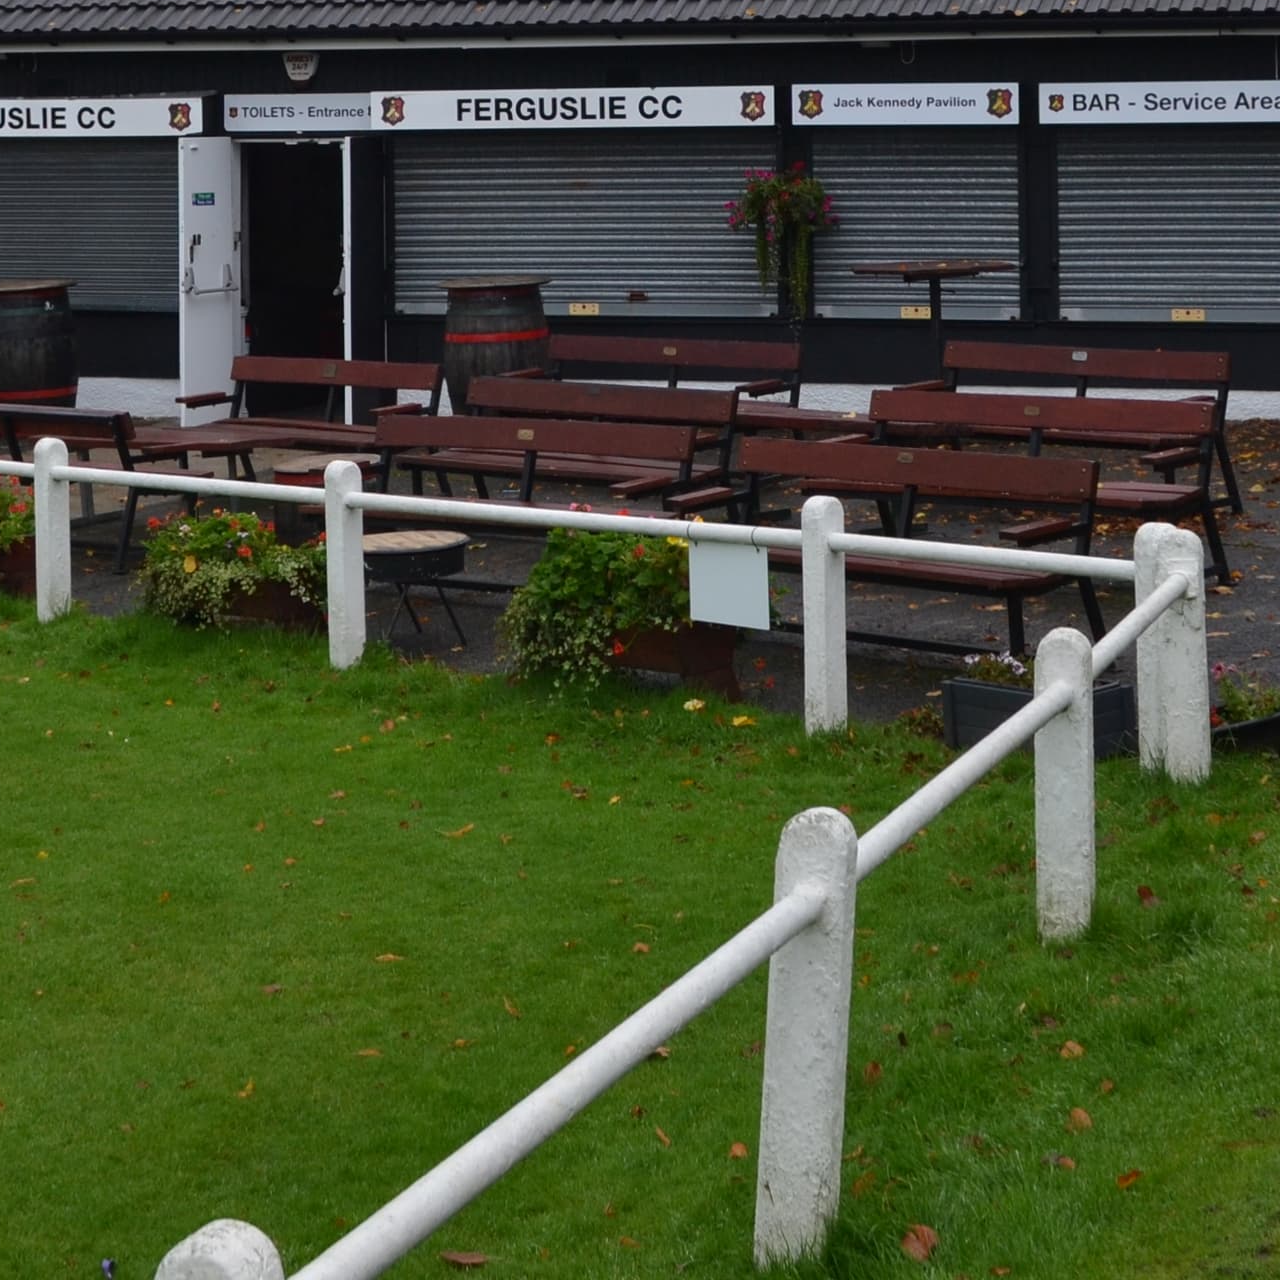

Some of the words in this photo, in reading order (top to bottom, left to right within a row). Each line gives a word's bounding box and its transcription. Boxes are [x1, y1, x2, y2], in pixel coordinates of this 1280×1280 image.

[457, 96, 626, 121] FERGUSLIE
[638, 95, 683, 119] CC
[833, 97, 863, 108] Jack
[867, 97, 922, 110] Kennedy
[926, 96, 977, 108] Pavilion
[1072, 93, 1120, 111] BAR
[1144, 92, 1227, 111] Service
[77, 106, 116, 129] CC
[241, 106, 295, 118] TOILETS
[308, 106, 364, 118] Entrance
